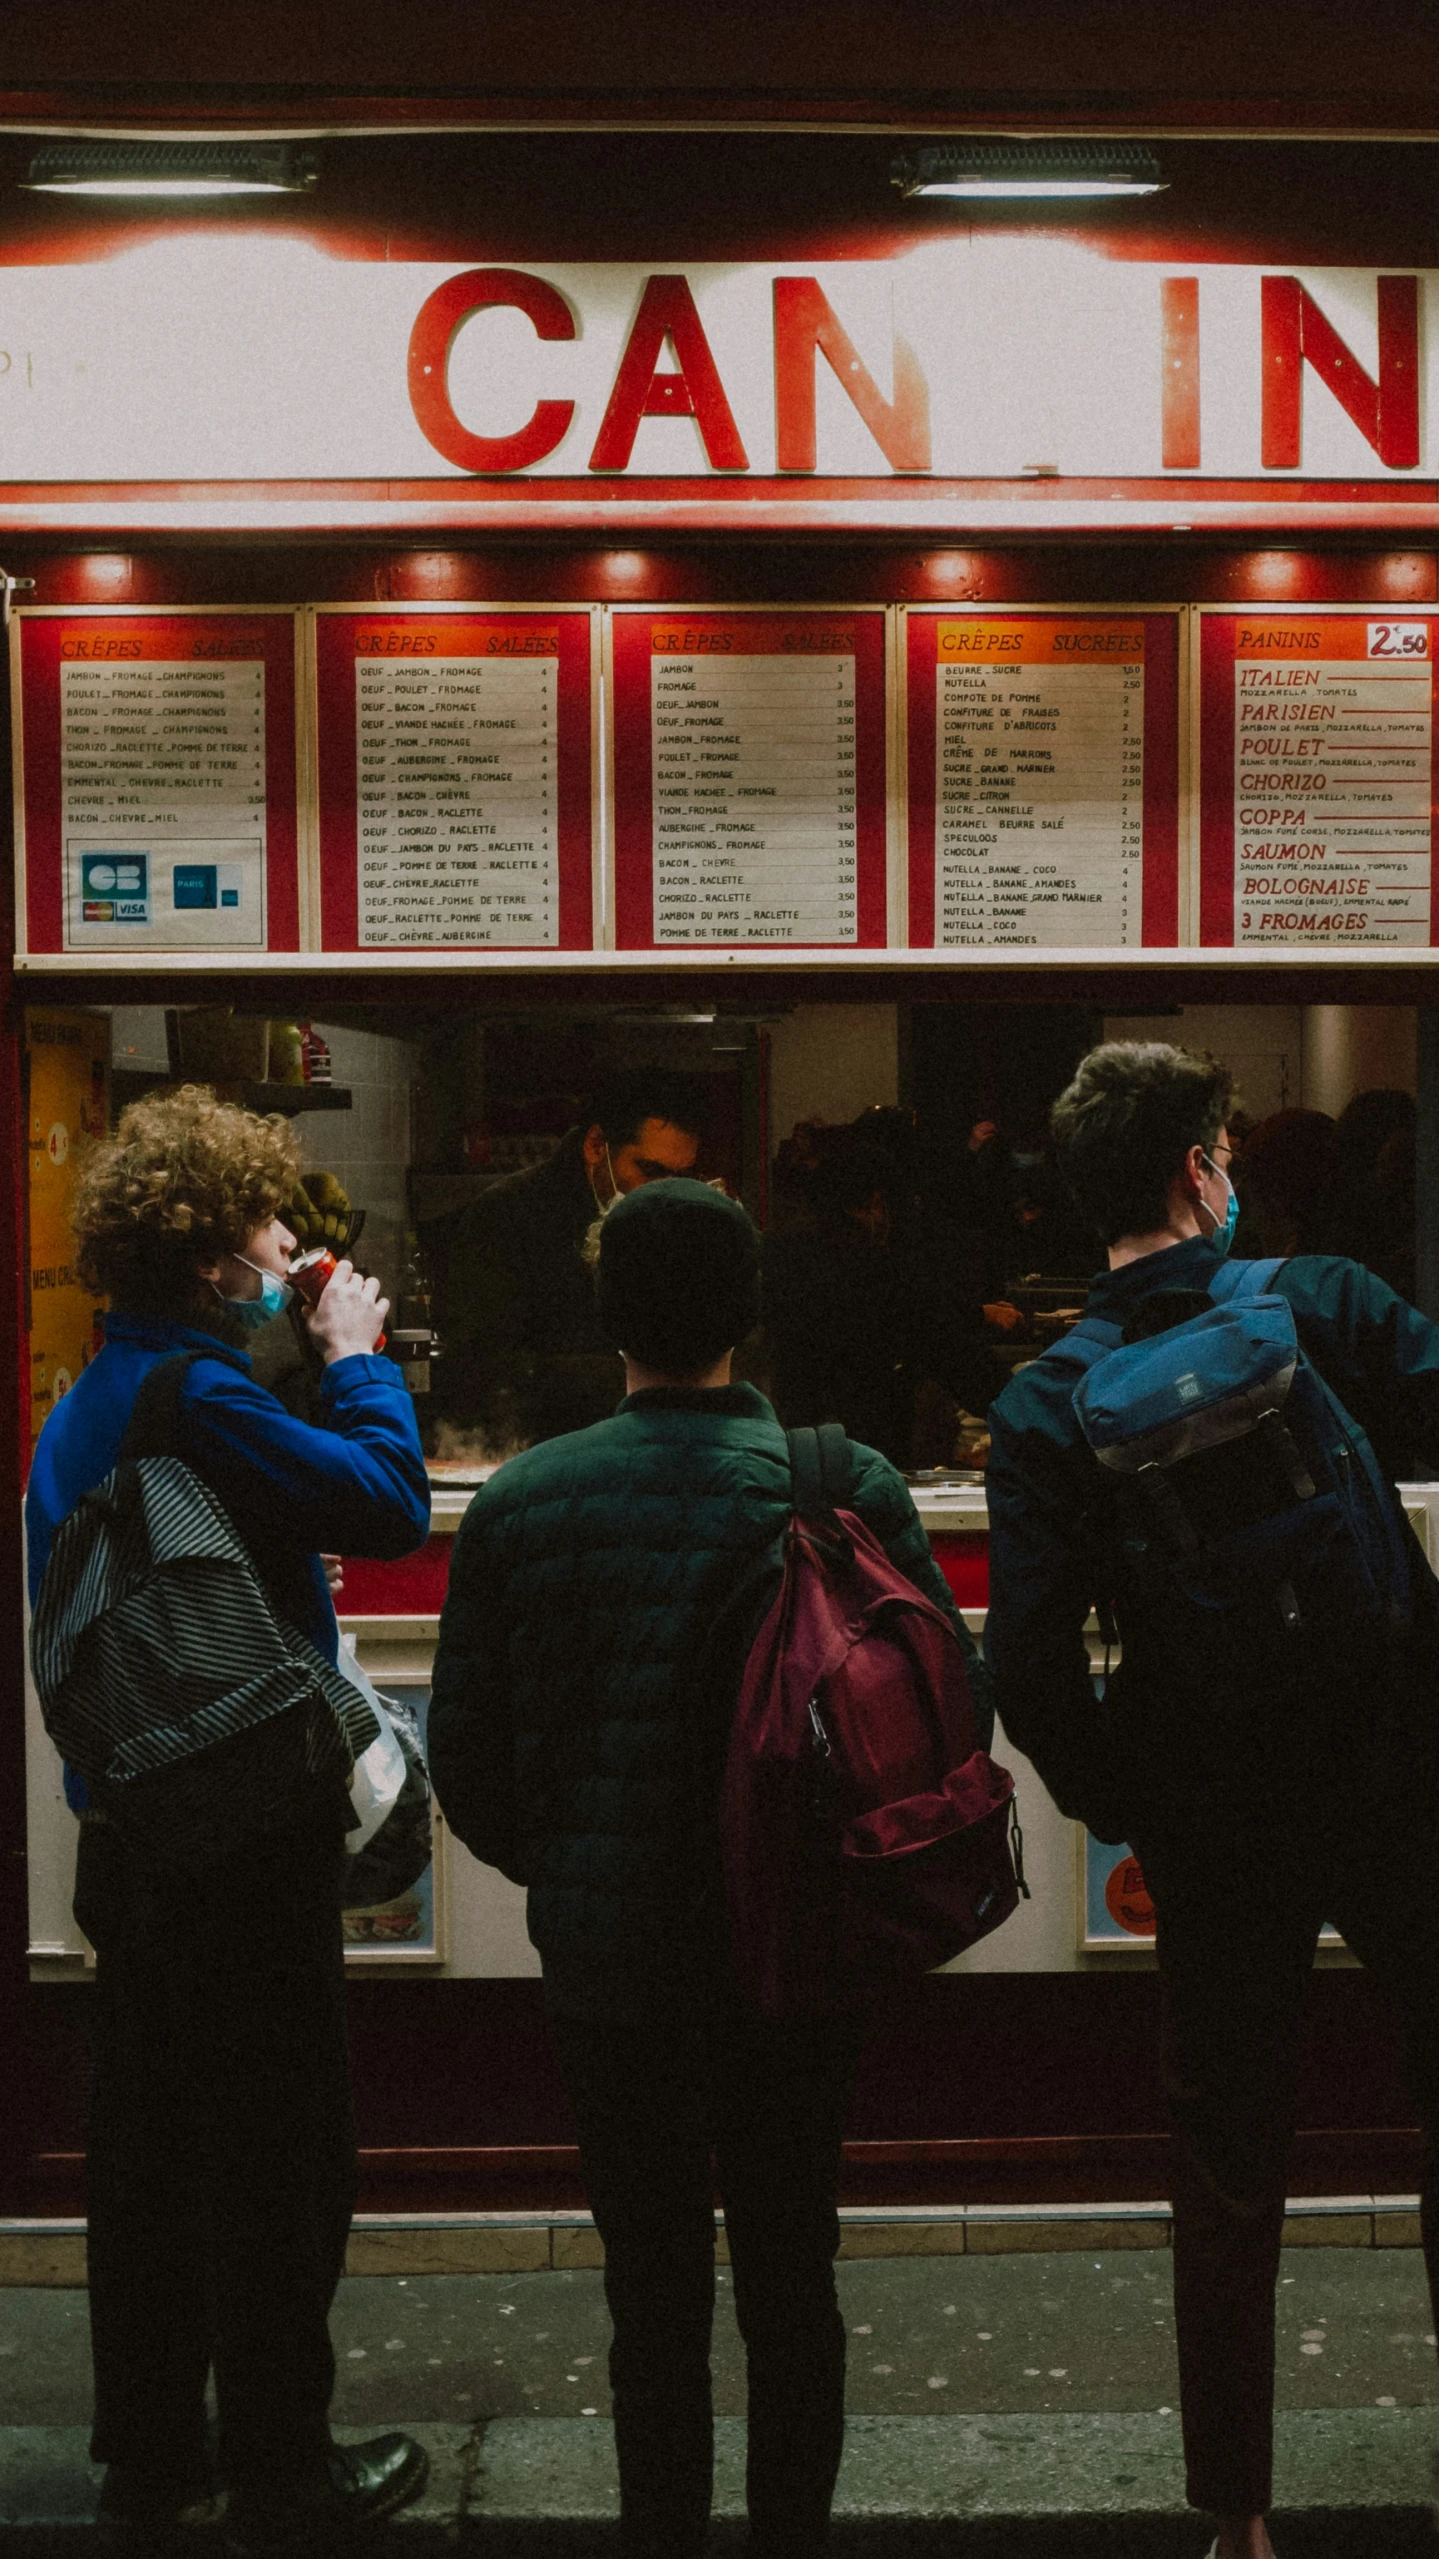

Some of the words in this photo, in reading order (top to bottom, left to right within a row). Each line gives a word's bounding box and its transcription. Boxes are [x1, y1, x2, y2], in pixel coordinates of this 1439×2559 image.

[942, 628, 1024, 651] CRÊPES
[1238, 630, 1321, 649] PANINIS
[361, 668, 384, 677] OEUF
[394, 668, 430, 677] JAMBON
[440, 667, 483, 677] FROMAGE
[541, 668, 547, 677] 4
[659, 665, 693, 674] JAMBON
[837, 664, 843, 673] 3
[945, 666, 982, 675] BEURRE
[992, 666, 1022, 675] SUCRE
[66, 672, 101, 681] JAMBON
[112, 671, 153, 681] FROMAGE
[162, 671, 225, 681] CHAMPIGNONS
[255, 672, 261, 680] 4
[1239, 668, 1321, 687] ITALIEN
[657, 682, 696, 691] FROMAGE
[837, 682, 843, 690] 3
[945, 679, 986, 688] NUTELLA
[361, 685, 384, 694] OEUF
[395, 685, 428, 694] POULET
[438, 685, 481, 694] FROMAGE
[541, 686, 547, 694] 4
[1240, 689, 1307, 697] MOZZARELLA
[1317, 689, 1358, 697] TOMATES
[944, 693, 986, 703] COMPOTE
[991, 693, 1003, 703] DE
[1009, 693, 1041, 703] POMME
[1123, 696, 1129, 704] 2
[944, 708, 993, 717] CONFITURE
[1000, 708, 1011, 717] DE
[1022, 708, 1060, 717] FRAISES
[1123, 709, 1129, 717] 2
[1239, 704, 1336, 721] PARISIEN
[66, 725, 90, 735] THON
[103, 725, 147, 735] FROMAGE
[163, 725, 228, 735] CHAMPIGNONS
[253, 726, 260, 735] 4
[1240, 724, 1277, 733] JAMBON
[1280, 724, 1291, 732] DE
[657, 735, 692, 745] JAMBON
[701, 735, 741, 744] FROMAGE
[945, 735, 966, 745] MIEL
[66, 743, 107, 752] CHORIZO
[116, 742, 163, 752] RACLETTE
[171, 743, 203, 753] POMME
[206, 743, 218, 752] DE
[221, 743, 248, 753] TERRE
[253, 744, 260, 753] 4
[1240, 738, 1325, 756] POULET
[659, 753, 691, 762] POULET
[701, 752, 740, 761] FROMAGE
[1240, 773, 1327, 791] CHORIZO
[117, 795, 141, 805] MIEL
[362, 809, 387, 818] OEUF
[398, 808, 428, 818] BACON
[437, 808, 483, 817] RACLETTE
[542, 808, 548, 817] 4
[944, 805, 975, 815] SUCRE
[985, 805, 1034, 815] CANNELLE
[1122, 807, 1128, 816] 2
[68, 813, 99, 824] BACON
[154, 813, 179, 823] MIEL
[252, 813, 259, 822] 4
[1239, 808, 1306, 826] COPPA
[943, 820, 988, 829] CARAMEL
[999, 820, 1035, 829] BEURRE
[1041, 816, 1064, 829] SALÉ
[362, 827, 387, 837] OEUF
[398, 826, 437, 836] CHORIZO
[449, 825, 497, 835] RACLETTE
[541, 826, 548, 835] 4
[944, 834, 998, 843] SPECULOOS
[658, 840, 717, 850] CHAMPIGNONS
[726, 840, 766, 850] FROMAGE
[943, 848, 989, 857] CHOCOLAT
[1240, 843, 1327, 860] SAUMON
[364, 862, 388, 871] OEUF
[399, 861, 432, 871] POMME
[435, 861, 447, 871] DE
[451, 861, 478, 870] TERRE
[490, 860, 538, 870] RACLETTE
[543, 861, 548, 869] 4
[1240, 863, 1274, 871] SAUMON
[177, 880, 204, 888] PARIS
[659, 876, 690, 886] BACON
[700, 876, 744, 885] RACLETTE
[1242, 878, 1371, 895] BOLOGNAISE
[659, 893, 697, 903] CHORIZO
[705, 893, 751, 902] RACLETTE
[119, 904, 146, 915] VISA
[659, 911, 695, 921] JAMBON
[701, 911, 713, 920] DU
[718, 911, 739, 920] PAYS
[754, 910, 799, 920] RACLETTE
[943, 921, 984, 930] NUTELLA
[993, 921, 1017, 930] COCO
[1121, 922, 1127, 931] 3
[1241, 912, 1252, 930] 3
[1259, 913, 1369, 931] FROMAGES
[365, 932, 389, 941] OEUF
[441, 930, 491, 940] AUBERGINE
[543, 931, 549, 940] 4
[943, 935, 984, 944] NUTELLA
[994, 935, 1037, 945] AMANDES
[1121, 936, 1127, 945] 3
